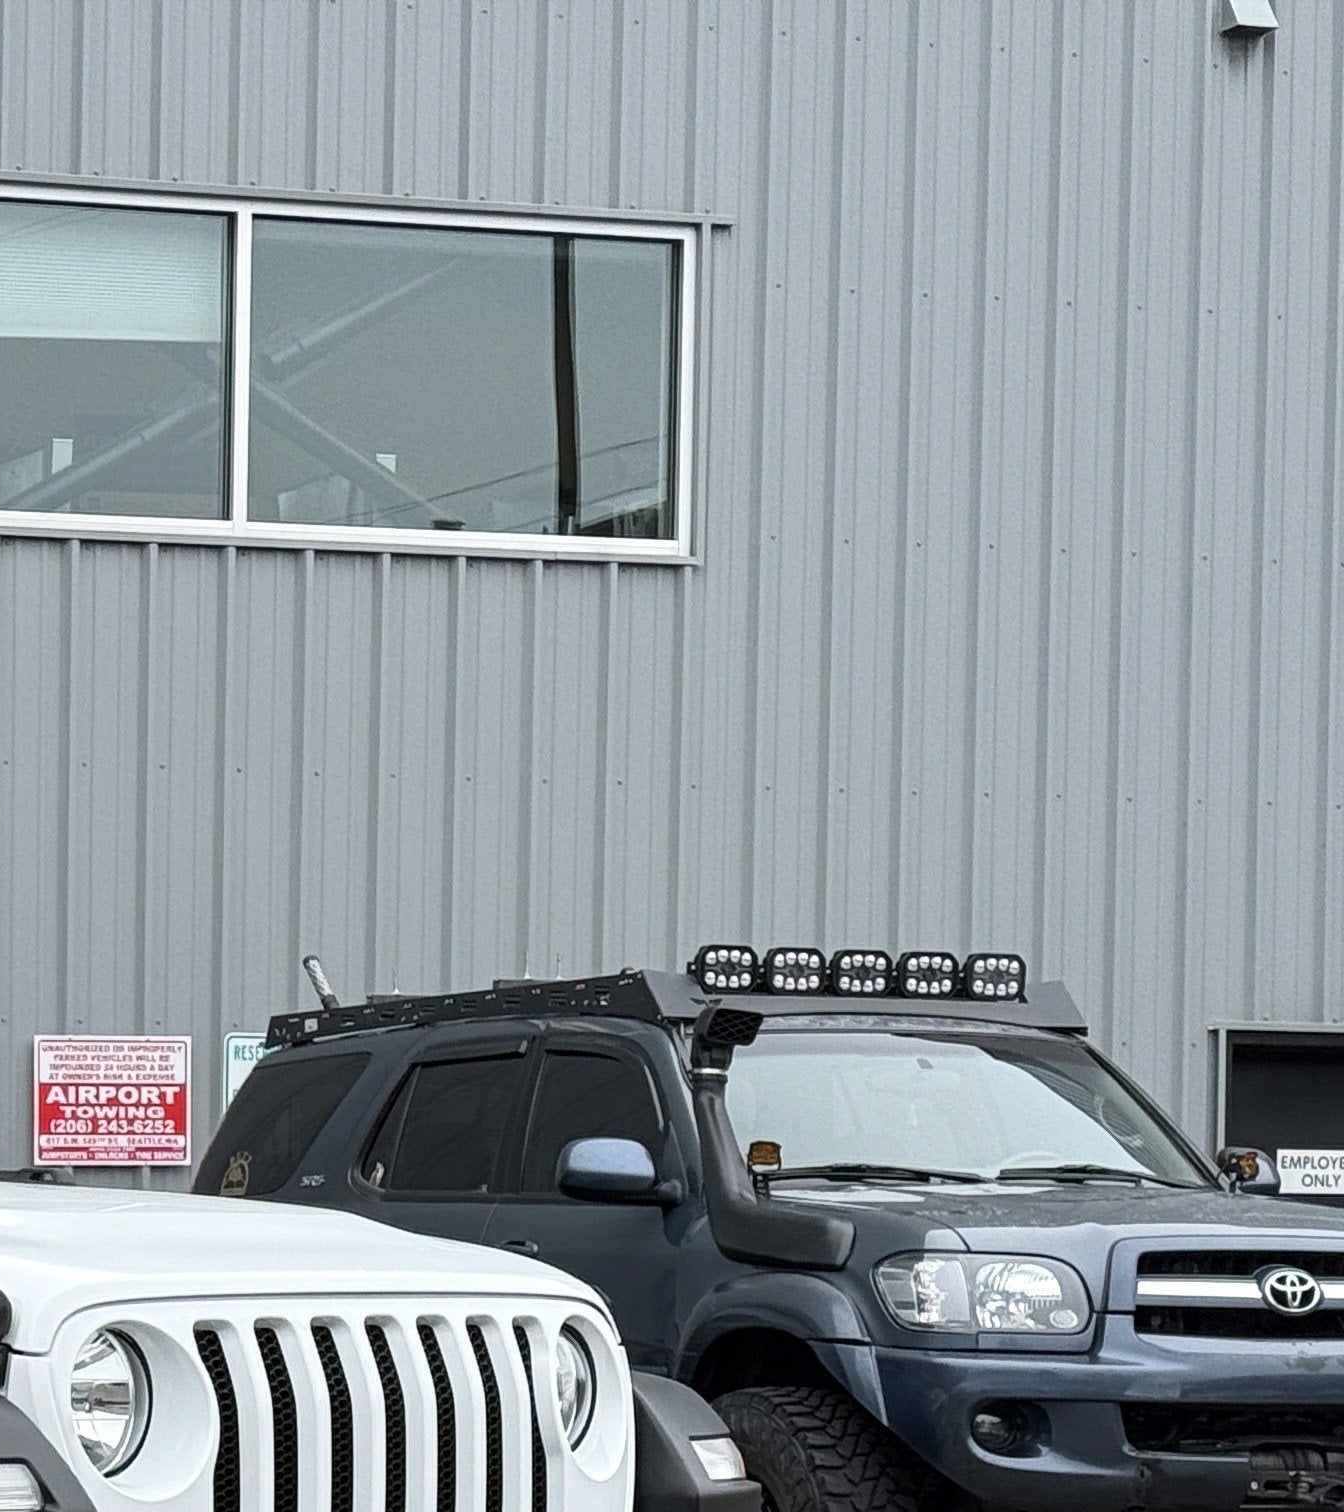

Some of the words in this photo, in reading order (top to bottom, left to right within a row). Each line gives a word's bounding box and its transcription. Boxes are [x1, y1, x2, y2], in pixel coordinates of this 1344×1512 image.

[45, 1085, 180, 1104] AIRPORT
[59, 1106, 165, 1119] TOWING
[50, 1119, 92, 1133] (206)
[97, 1119, 175, 1133] 243-6252
[1301, 1173, 1341, 1188] ONLY
